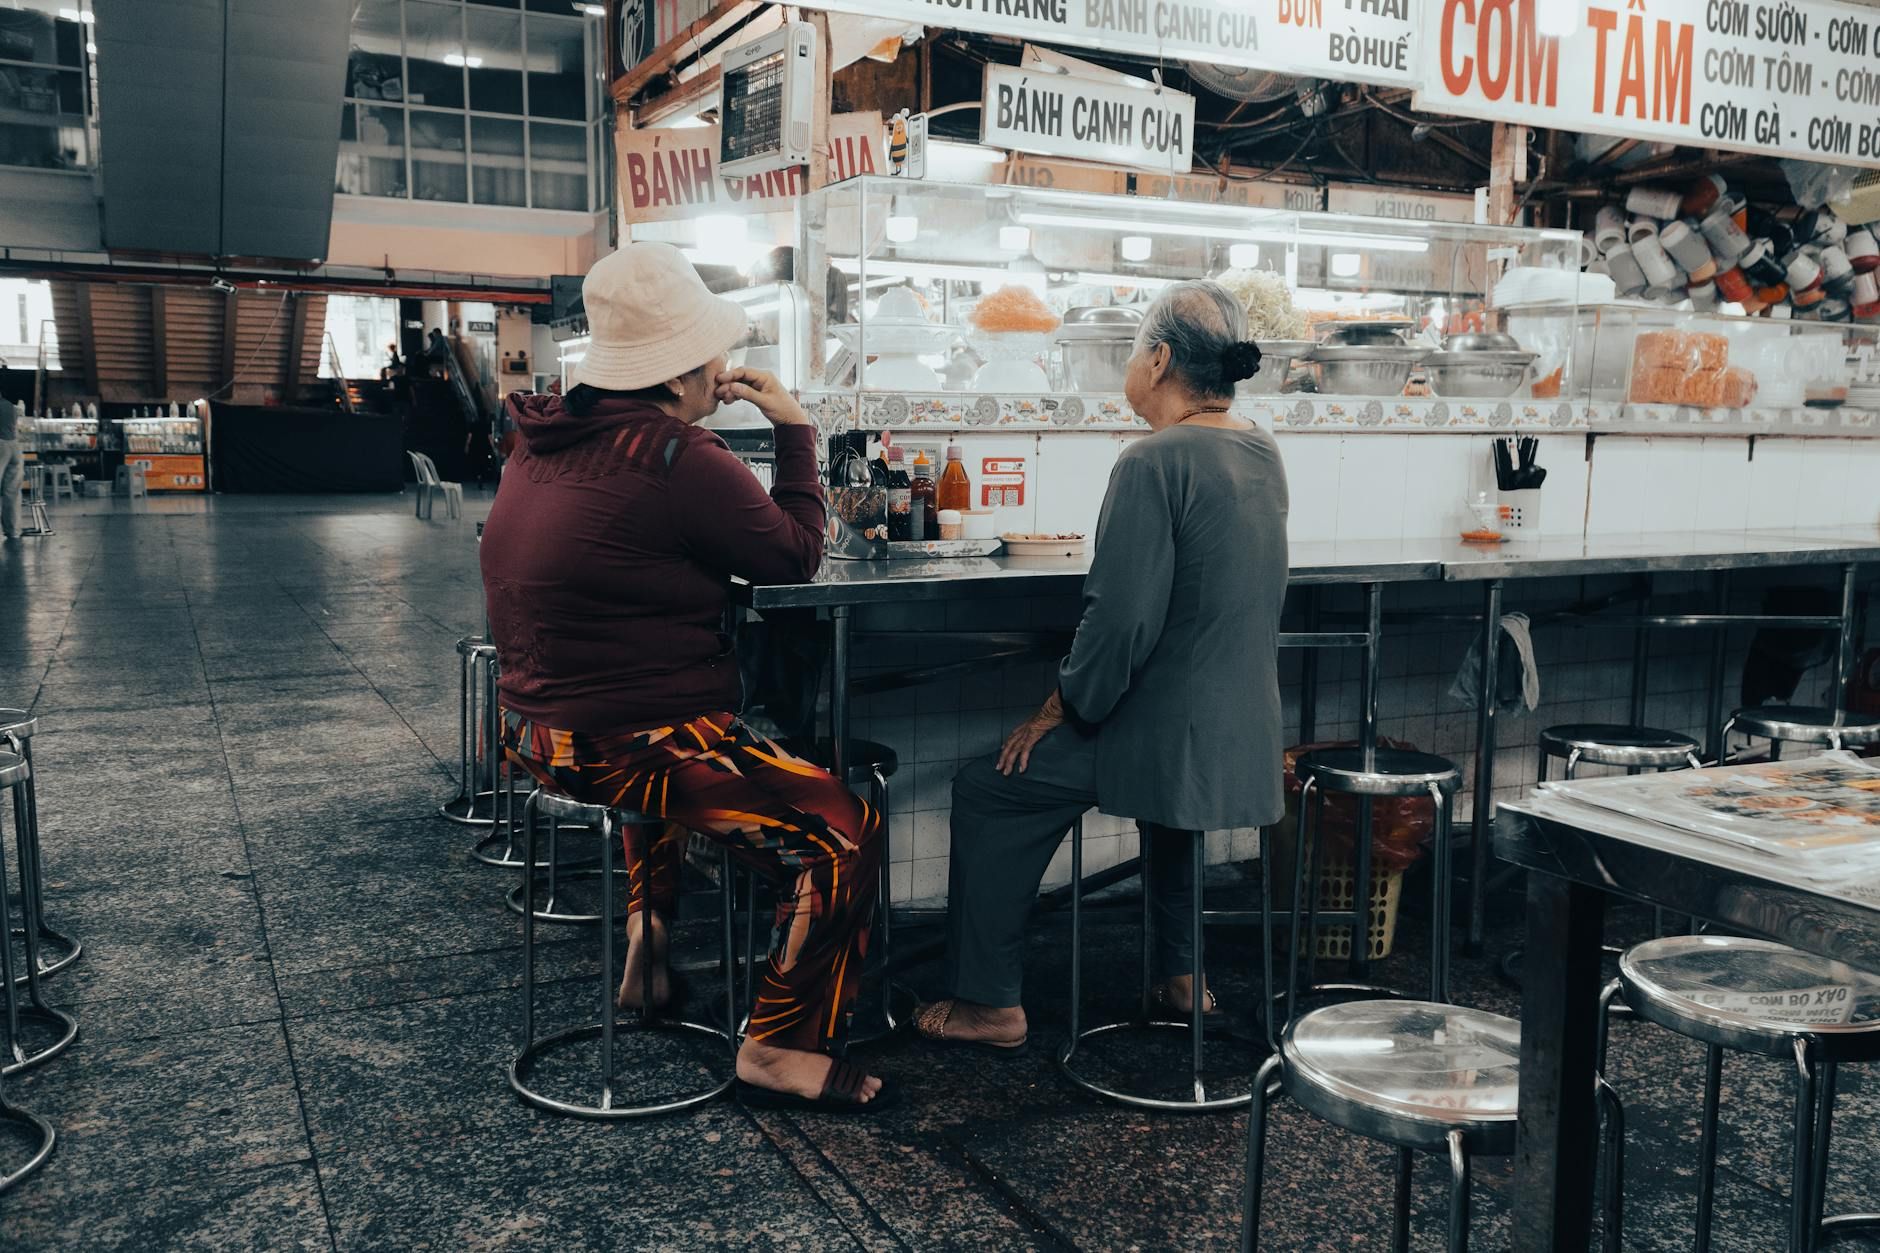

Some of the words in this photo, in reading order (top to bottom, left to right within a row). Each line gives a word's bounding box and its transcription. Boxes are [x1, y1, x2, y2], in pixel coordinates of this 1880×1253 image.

[1218, 11, 1259, 51] CUA
[1706, 0, 1749, 37] CƠM
[1755, 1, 1807, 46] SƯỜN
[1828, 16, 1868, 56] CƠM
[1704, 46, 1755, 88] CƠM
[1763, 51, 1813, 96] TÔM
[1836, 66, 1880, 106] CƠM
[997, 77, 1064, 137] BÁNH
[1072, 96, 1133, 146] CANH
[1141, 107, 1183, 154] CUA
[1701, 101, 1748, 141] CƠM
[1754, 102, 1780, 145] GÀ
[1808, 115, 1852, 154] CƠM
[627, 136, 716, 208] BÁNH
[828, 135, 876, 181] UA
